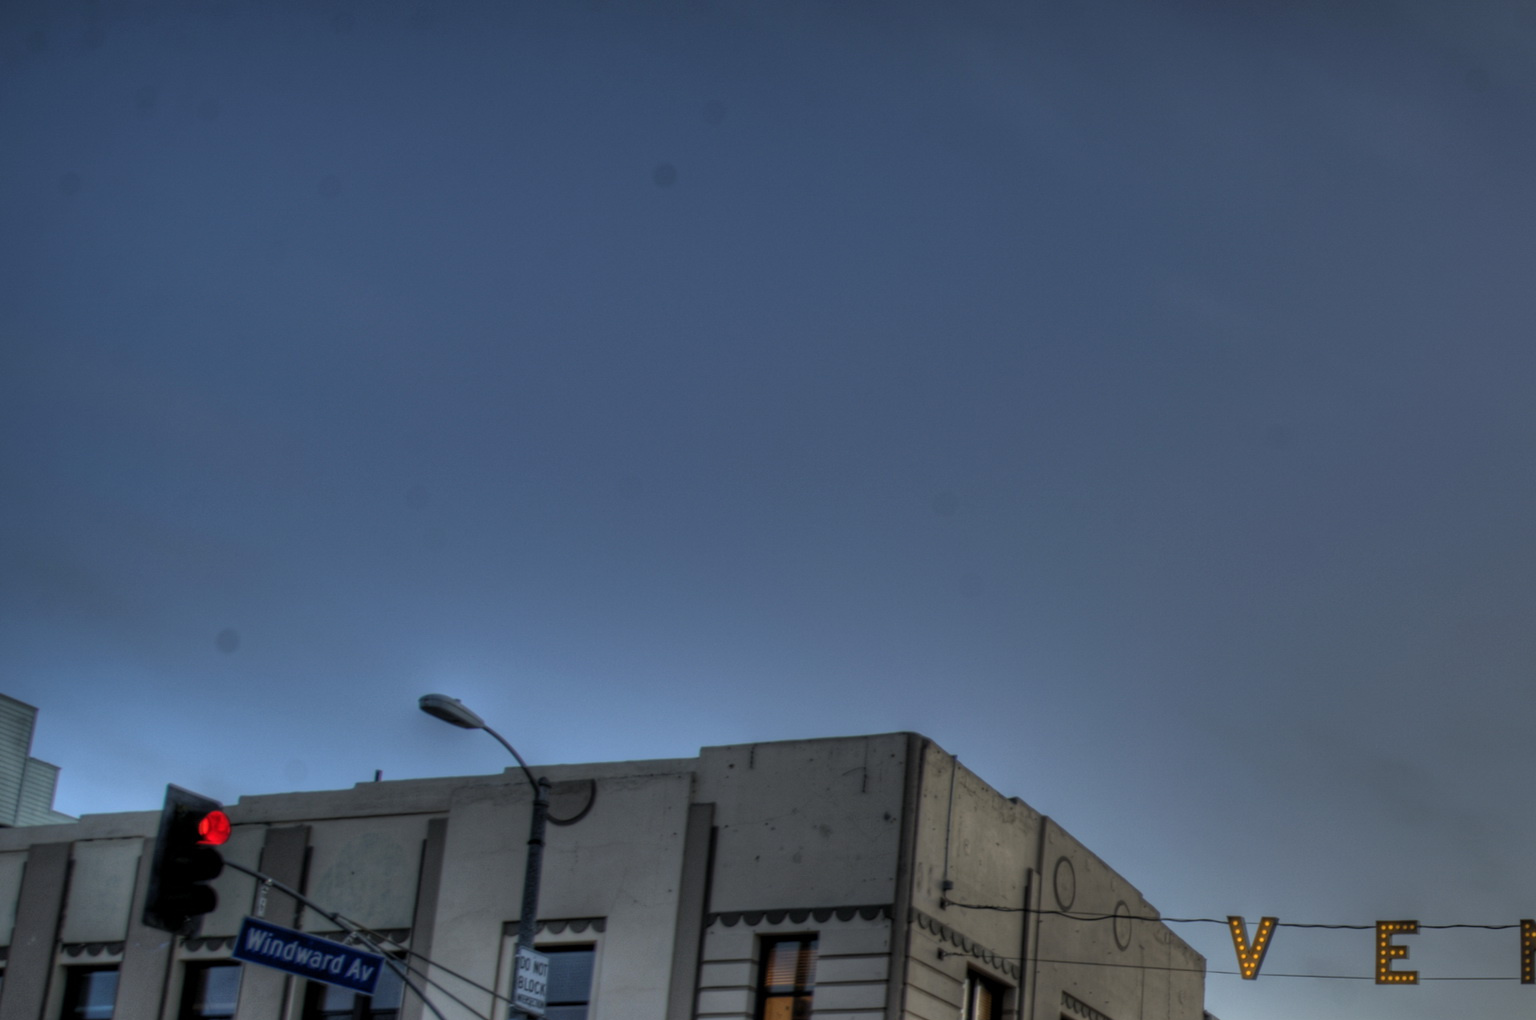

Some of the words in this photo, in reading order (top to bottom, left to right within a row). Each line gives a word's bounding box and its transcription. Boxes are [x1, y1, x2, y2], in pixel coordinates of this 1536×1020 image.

[245, 927, 346, 975] Windward
[345, 957, 375, 982] Av
[519, 956, 531, 971] DO
[534, 959, 548, 977] NOT
[517, 975, 546, 996] BLOCK
